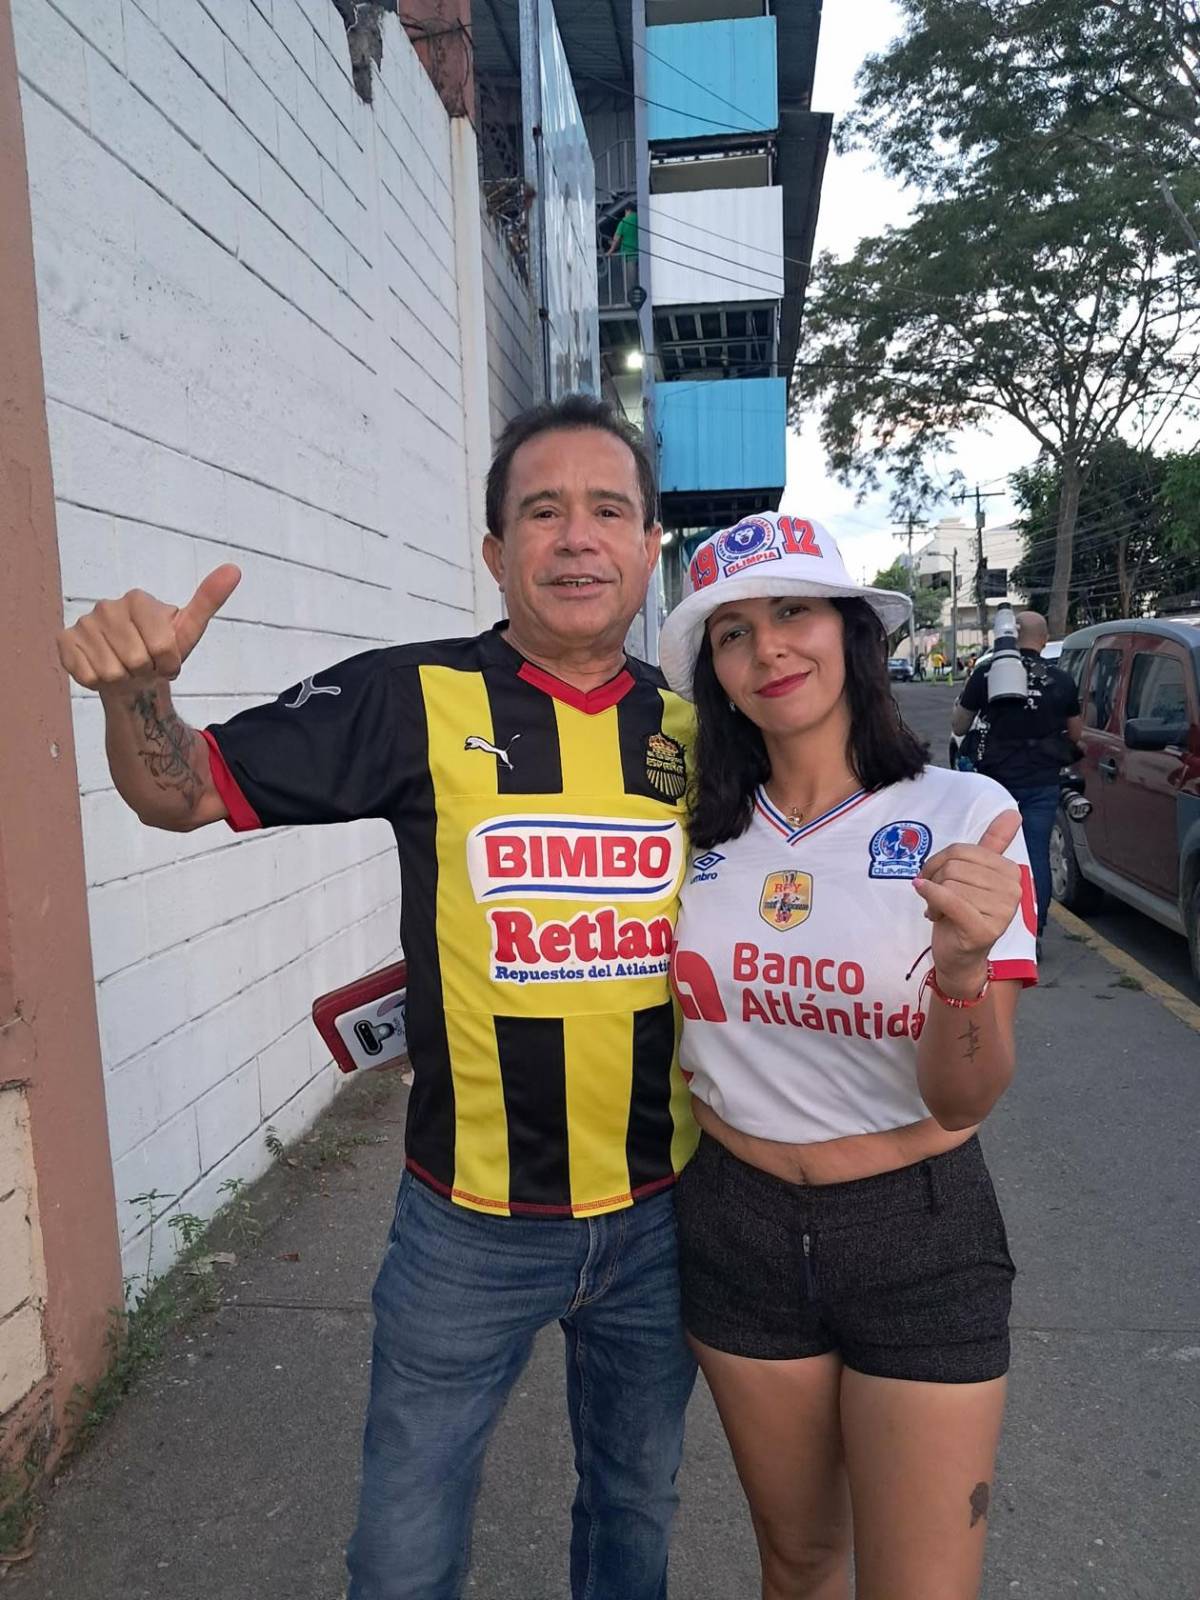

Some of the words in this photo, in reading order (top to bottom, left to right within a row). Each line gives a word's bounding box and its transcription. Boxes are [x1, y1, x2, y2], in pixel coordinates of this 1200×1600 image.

[777, 516, 823, 557] 12
[728, 551, 777, 573] OLIMPIA
[485, 836, 672, 879] BIMBO
[690, 872, 718, 884] mbro
[491, 909, 673, 964] Retlan
[495, 965, 585, 983] Repuestos
[588, 965, 611, 978] del
[733, 942, 865, 995] Banco
[742, 987, 926, 1041] Atlántida
